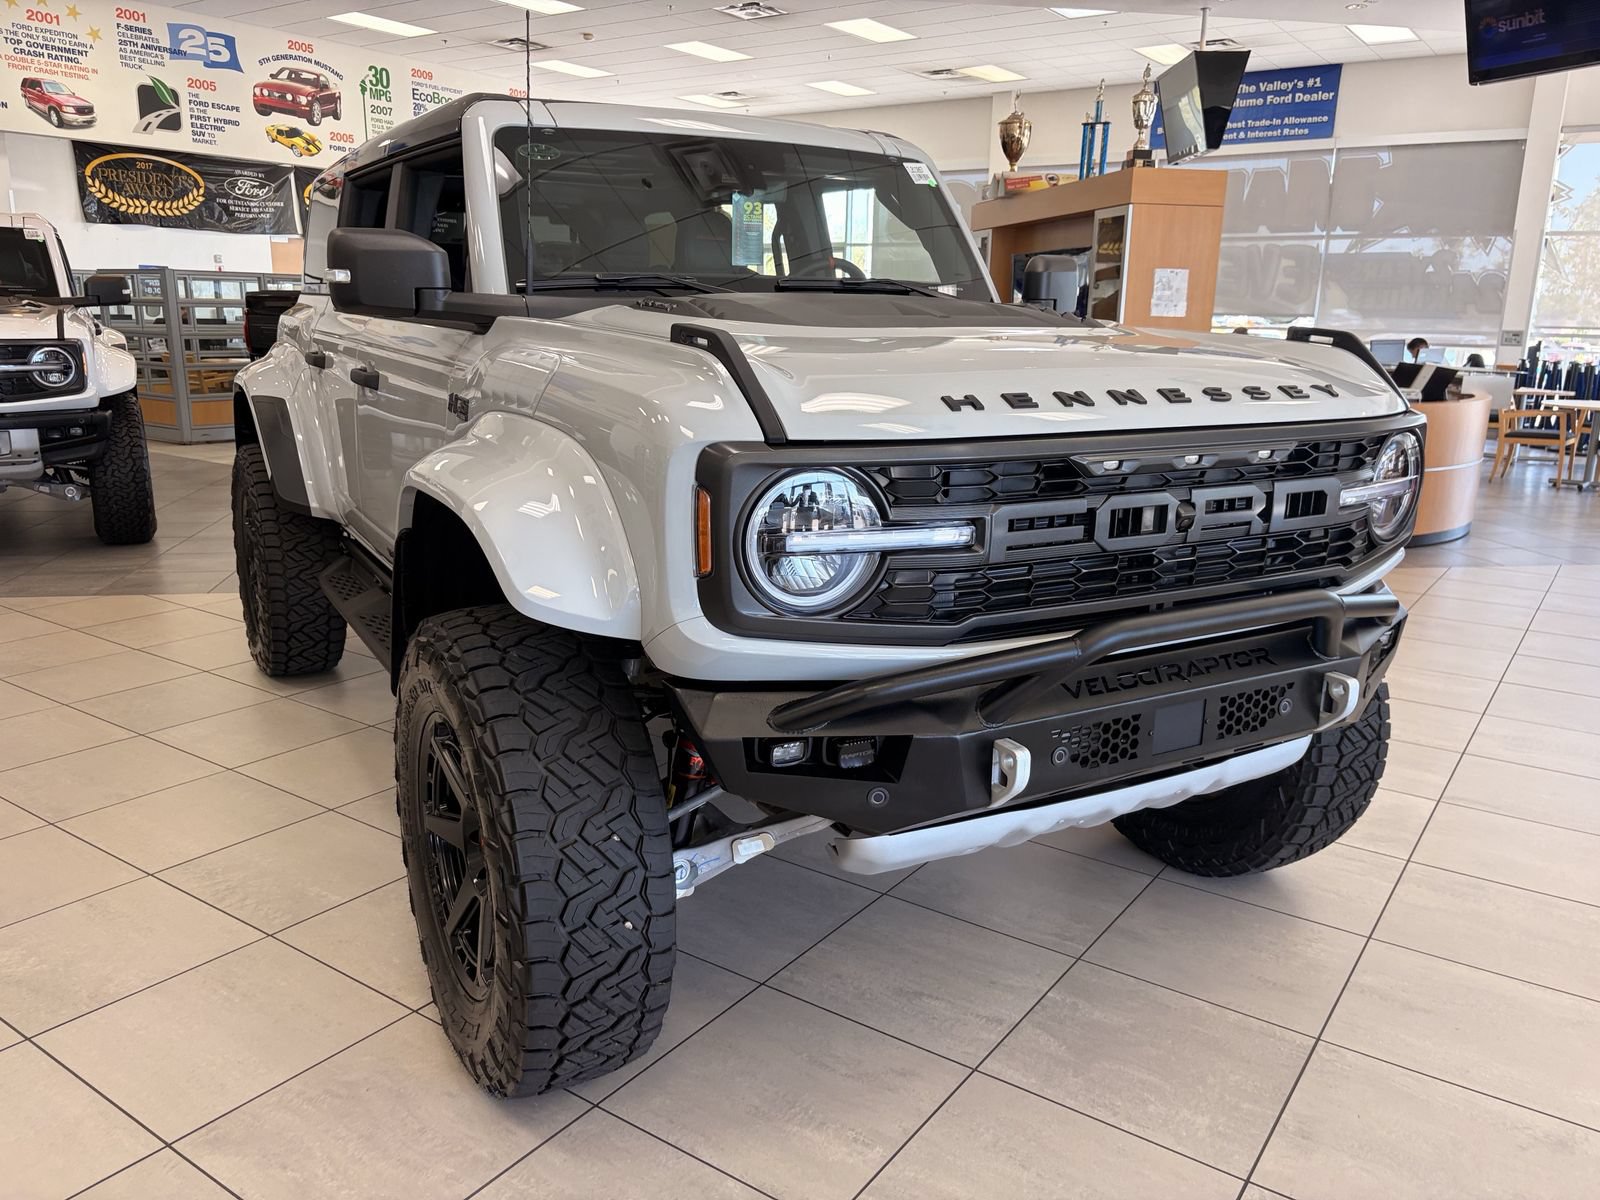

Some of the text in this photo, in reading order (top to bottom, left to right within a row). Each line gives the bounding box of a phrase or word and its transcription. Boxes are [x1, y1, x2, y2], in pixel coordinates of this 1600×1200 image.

[25, 9, 60, 26] 2001
[115, 7, 146, 23] 2001
[1498, 8, 1545, 32] sunbit
[12, 22, 78, 40] FORD EXPEDITION
[116, 23, 152, 36] F-SERIES
[5, 28, 20, 37] THE
[21, 32, 40, 40] ONLY
[42, 36, 56, 44] SUV
[69, 41, 87, 49] EARN
[117, 32, 160, 44] CELEBRATES
[178, 28, 230, 63] 25
[3, 36, 88, 57] TOP GOVERNMENT
[118, 39, 188, 56] 25TH ANIVERSARY
[130, 48, 164, 60] AMERICA'S
[288, 40, 314, 54] 2005
[13, 48, 82, 64] CRASH RATING.
[120, 55, 166, 67] BEST SELLING
[5, 54, 36, 64] DOUBLE
[37, 59, 62, 68] 5-STAR
[64, 64, 90, 74] RATING
[8, 63, 91, 80] FRONT CRASH TESTING.
[120, 62, 144, 71] TRUCK.
[258, 54, 344, 80] 5TH GENERATION MUSTANG
[368, 65, 390, 90] 30
[411, 68, 433, 80] 2009
[186, 77, 216, 92] 2005
[412, 80, 428, 89] FORD'S
[1260, 79, 1304, 92] Valley's
[1306, 77, 1322, 88] #1
[370, 88, 392, 102] MPG
[1232, 92, 1334, 108] lume Ford Dealer
[188, 99, 240, 113] FORD ESCAPE
[370, 104, 392, 116] 2007
[190, 114, 240, 127] FIRST HYBRID
[191, 122, 226, 132] ELECTRIC
[1226, 114, 1328, 130] hest Trade-In Allowance
[192, 129, 206, 138] SUV
[330, 132, 354, 144] 2005
[1238, 131, 1246, 139] &
[1247, 128, 1280, 138] Interest
[1283, 127, 1308, 136] Rates
[192, 137, 218, 146] MARKET.
[329, 144, 346, 152] FORD
[136, 162, 152, 170] 2017
[98, 168, 195, 188] PRESIDENT'S
[122, 183, 174, 198] AWARD
[235, 178, 268, 196] Ford
[744, 201, 762, 214] 93
[940, 383, 1340, 412] HENNESSEY
[989, 476, 1341, 564] FORD
[1060, 647, 1277, 699] VELOCIRAPTOR
